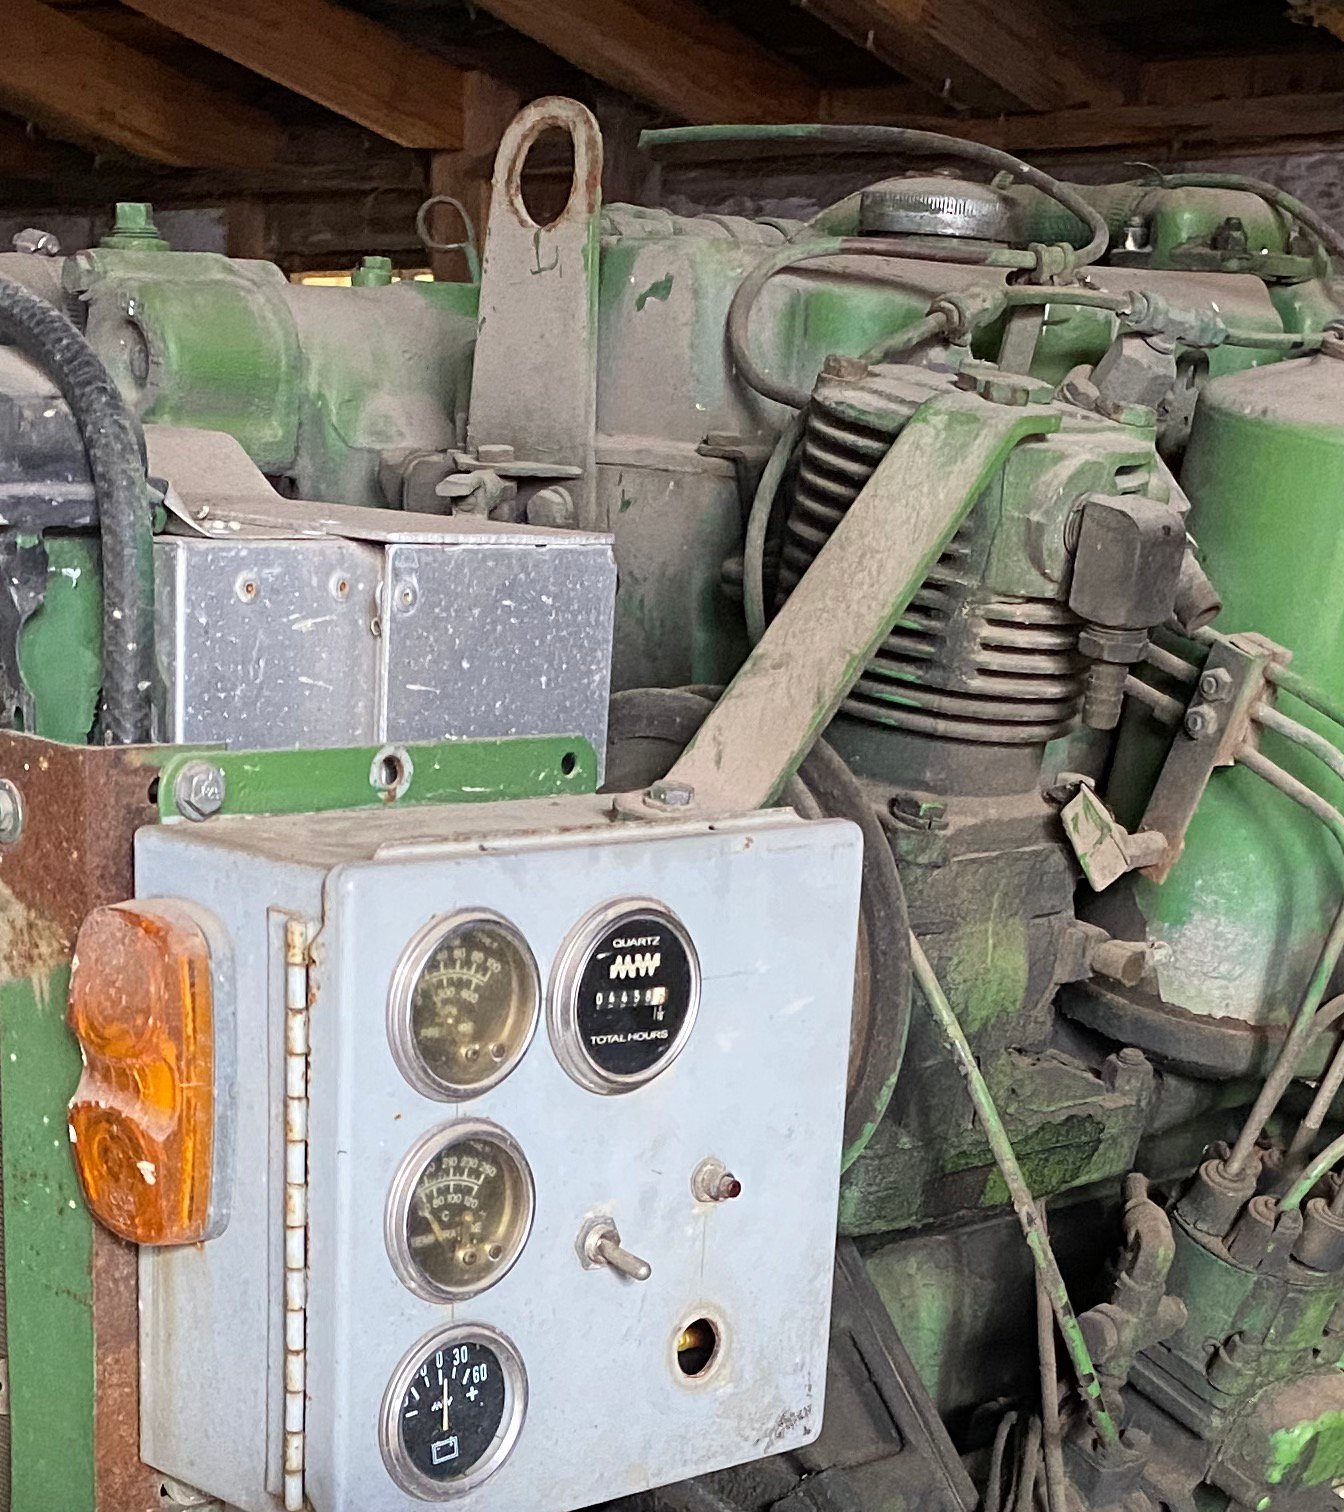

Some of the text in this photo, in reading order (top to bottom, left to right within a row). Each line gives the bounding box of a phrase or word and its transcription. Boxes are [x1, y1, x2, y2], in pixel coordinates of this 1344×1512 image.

[612, 936, 661, 949] QUARTZ
[590, 1029, 669, 1045] TOTAL HOURS
[447, 1194, 462, 1203] 100
[435, 1350, 444, 1369] 0
[452, 1345, 468, 1366] 30
[472, 1363, 488, 1384] 60
